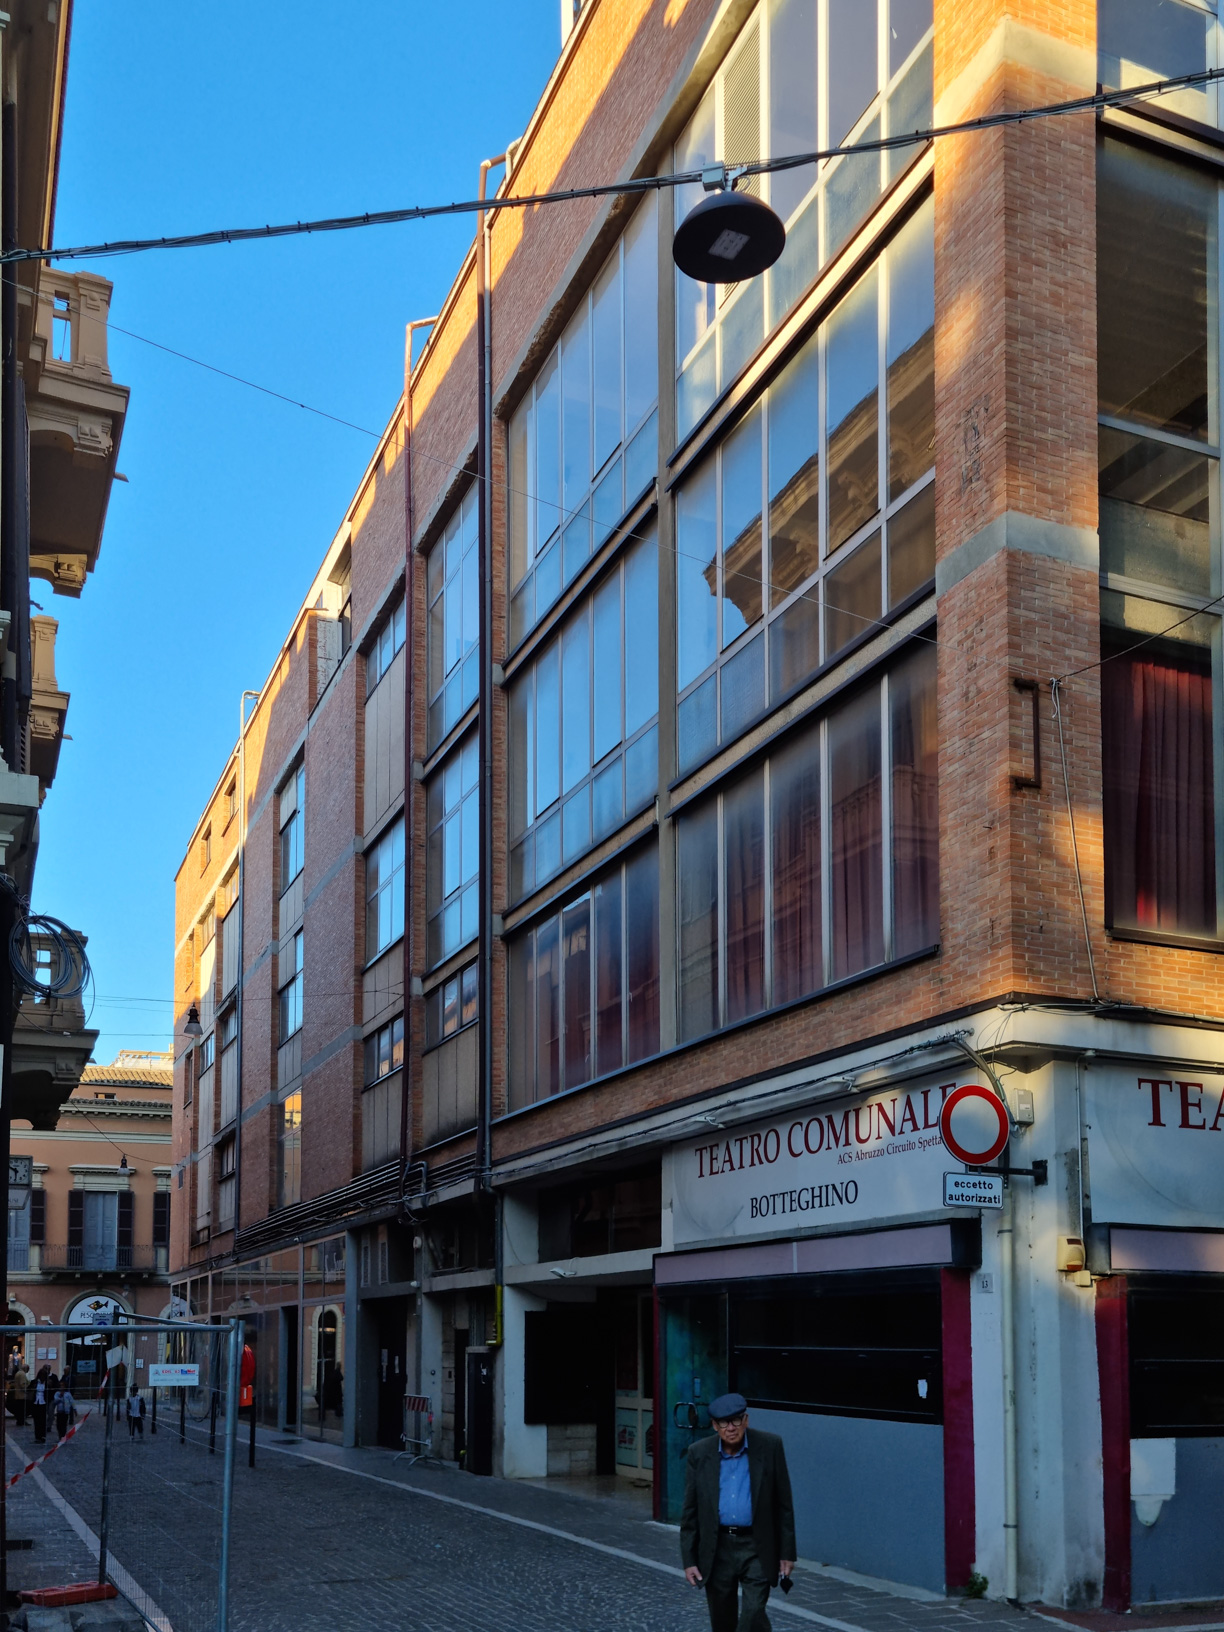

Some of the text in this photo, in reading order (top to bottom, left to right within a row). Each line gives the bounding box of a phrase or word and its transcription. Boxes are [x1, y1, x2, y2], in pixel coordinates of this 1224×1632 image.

[695, 1128, 781, 1178] TEATRO
[837, 1135, 942, 1165] ACS Abruzzo Circuito Spetta
[750, 1179, 859, 1219] BOTTEGHINO
[948, 1192, 1001, 1204] autorizzati
[954, 1180, 993, 1190] eccetto
